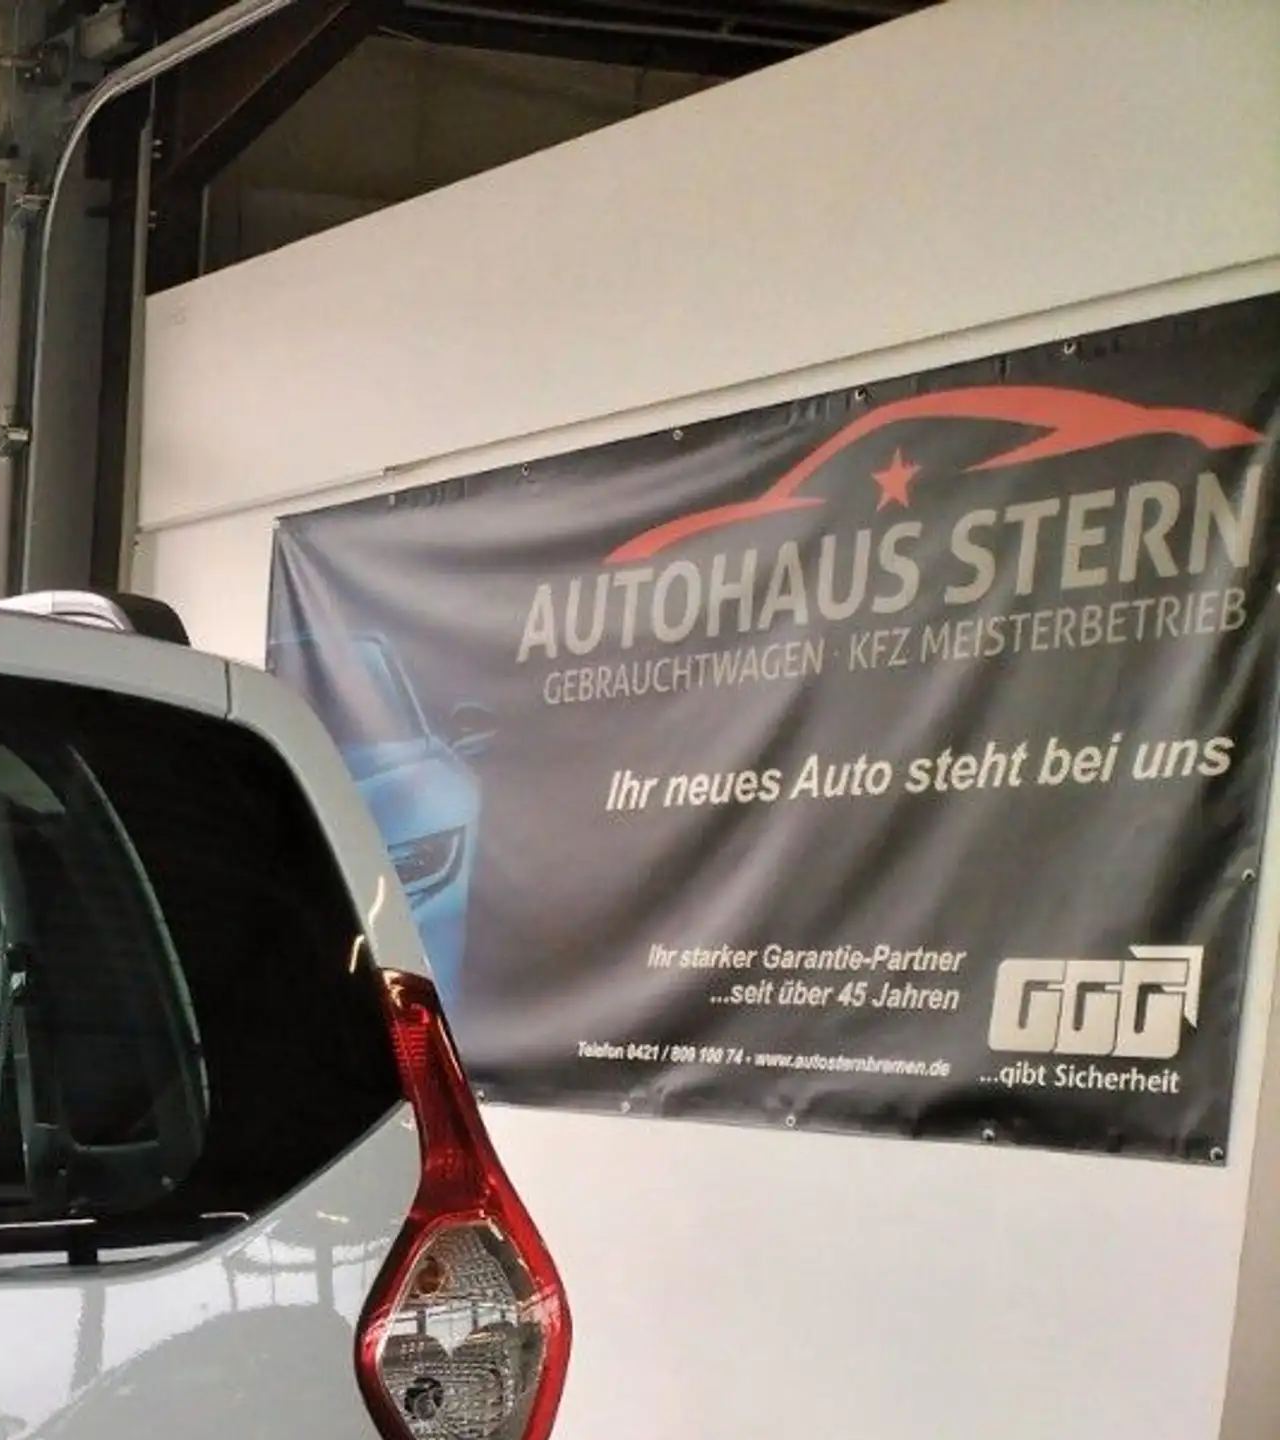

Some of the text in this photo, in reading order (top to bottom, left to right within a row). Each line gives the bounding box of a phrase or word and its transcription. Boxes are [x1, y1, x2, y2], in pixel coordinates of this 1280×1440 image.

[516, 463, 1263, 663] AUTOHAUS STERN
[543, 587, 1248, 705] GEBRAUCHTWAGEN KFZ MEISTERBETRIEB
[605, 734, 1234, 811] Ihr neues Auto steht bei uns
[647, 943, 967, 973] Ihr starker Garantie-Partner
[778, 979, 833, 1007] über
[837, 980, 868, 1009] 45
[871, 982, 960, 1012] Jahren
[1054, 1064, 1181, 1094] Sicherheit
